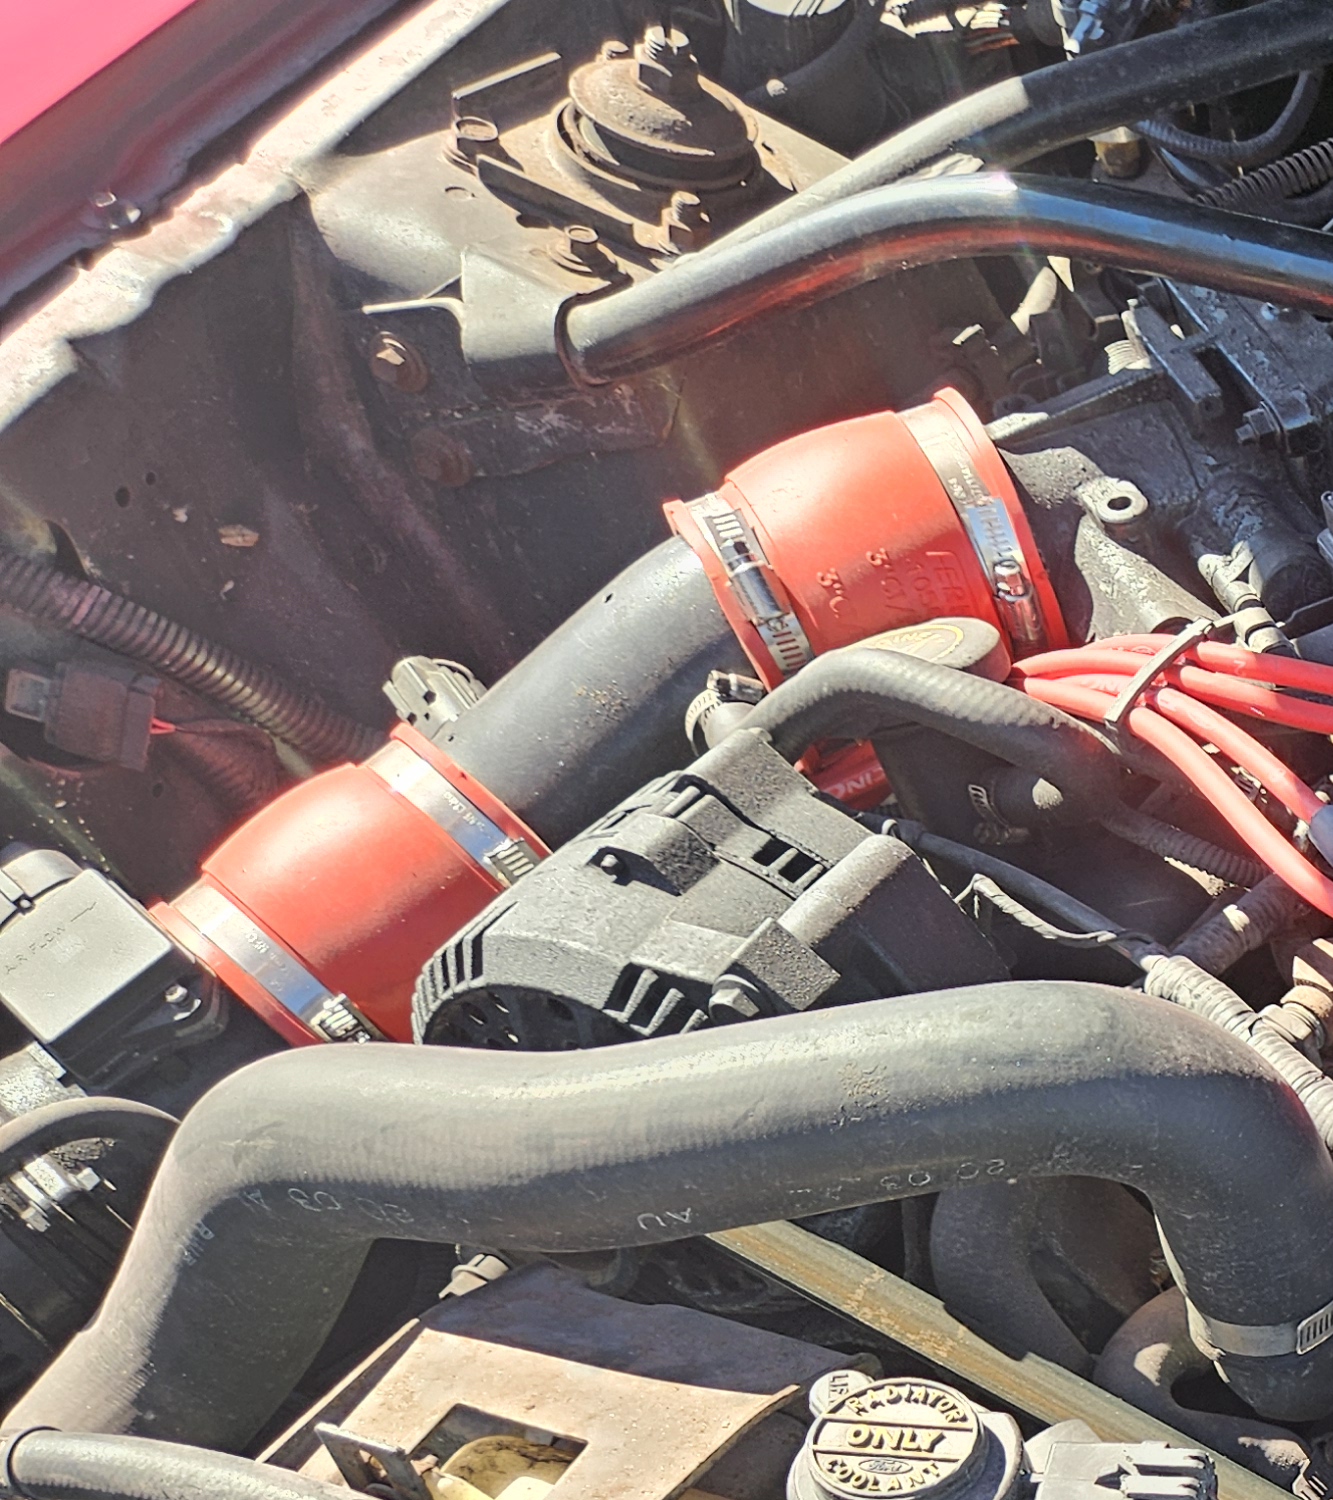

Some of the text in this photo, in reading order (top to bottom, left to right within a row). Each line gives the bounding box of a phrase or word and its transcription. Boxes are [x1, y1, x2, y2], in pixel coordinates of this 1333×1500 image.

[845, 1384, 968, 1424] RADIATOR
[848, 1424, 946, 1453] ONLY
[827, 1458, 941, 1492] COOLANT
